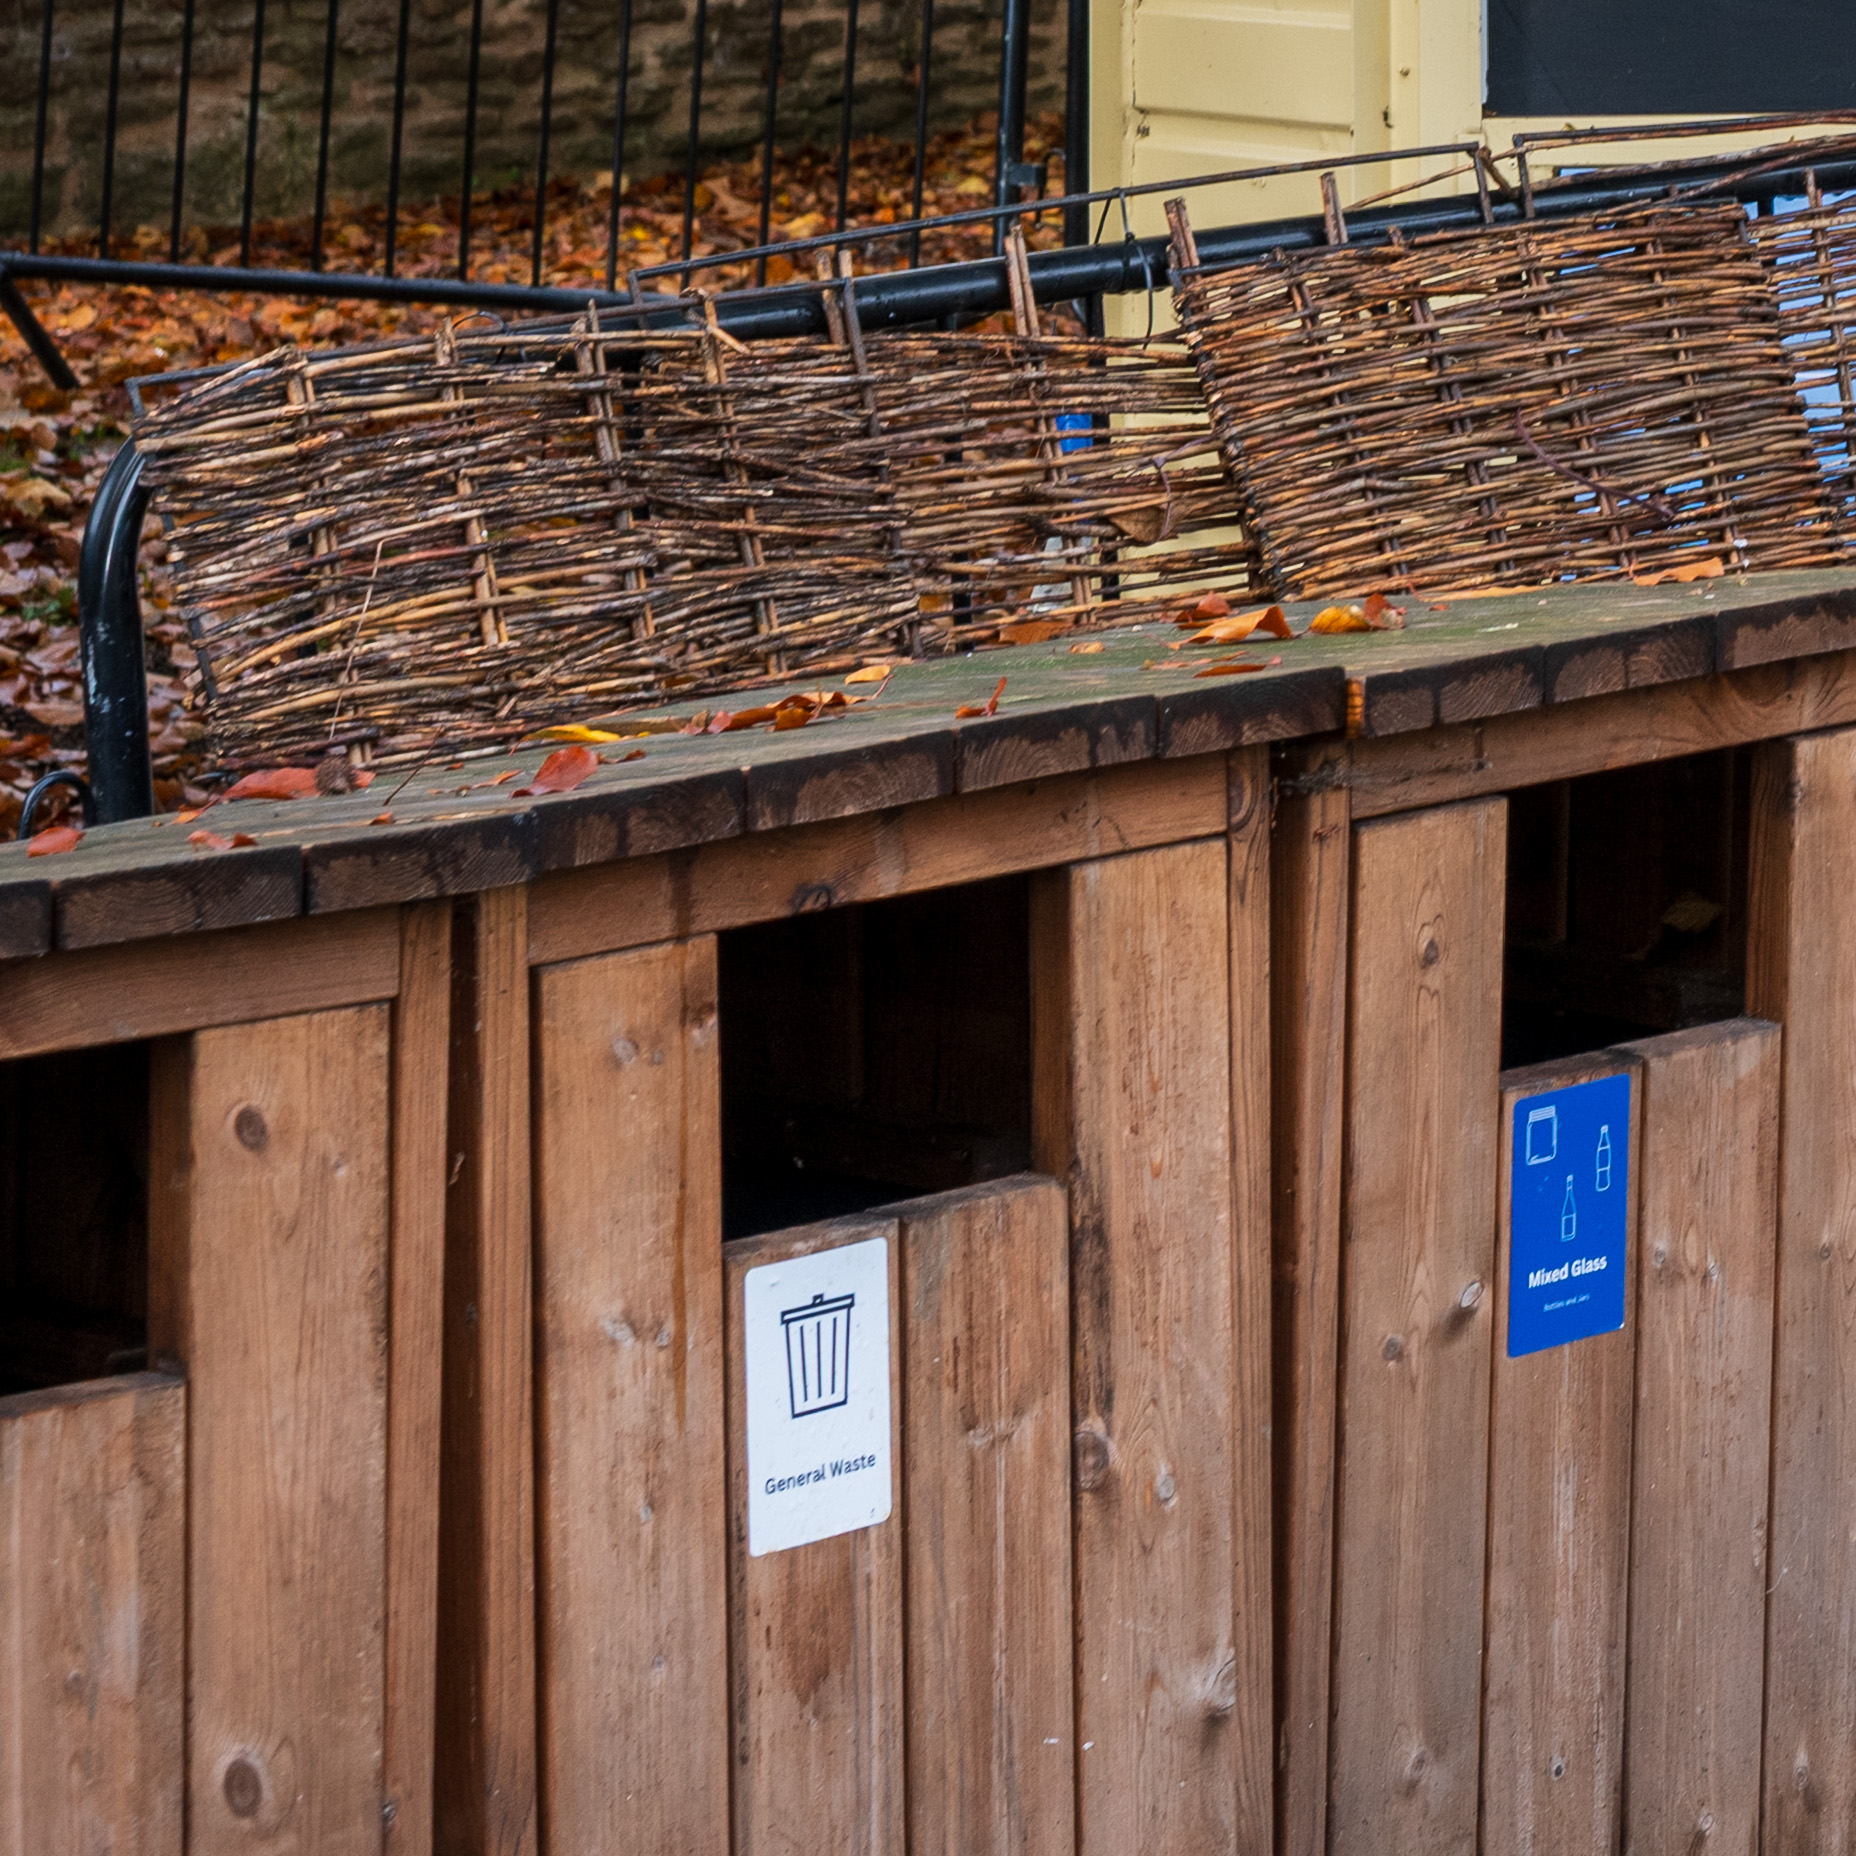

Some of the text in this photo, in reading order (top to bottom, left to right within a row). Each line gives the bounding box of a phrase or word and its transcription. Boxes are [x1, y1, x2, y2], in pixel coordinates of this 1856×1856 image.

[1528, 1255, 1608, 1289] Mixed Glass
[764, 1453, 877, 1496] General Waste
